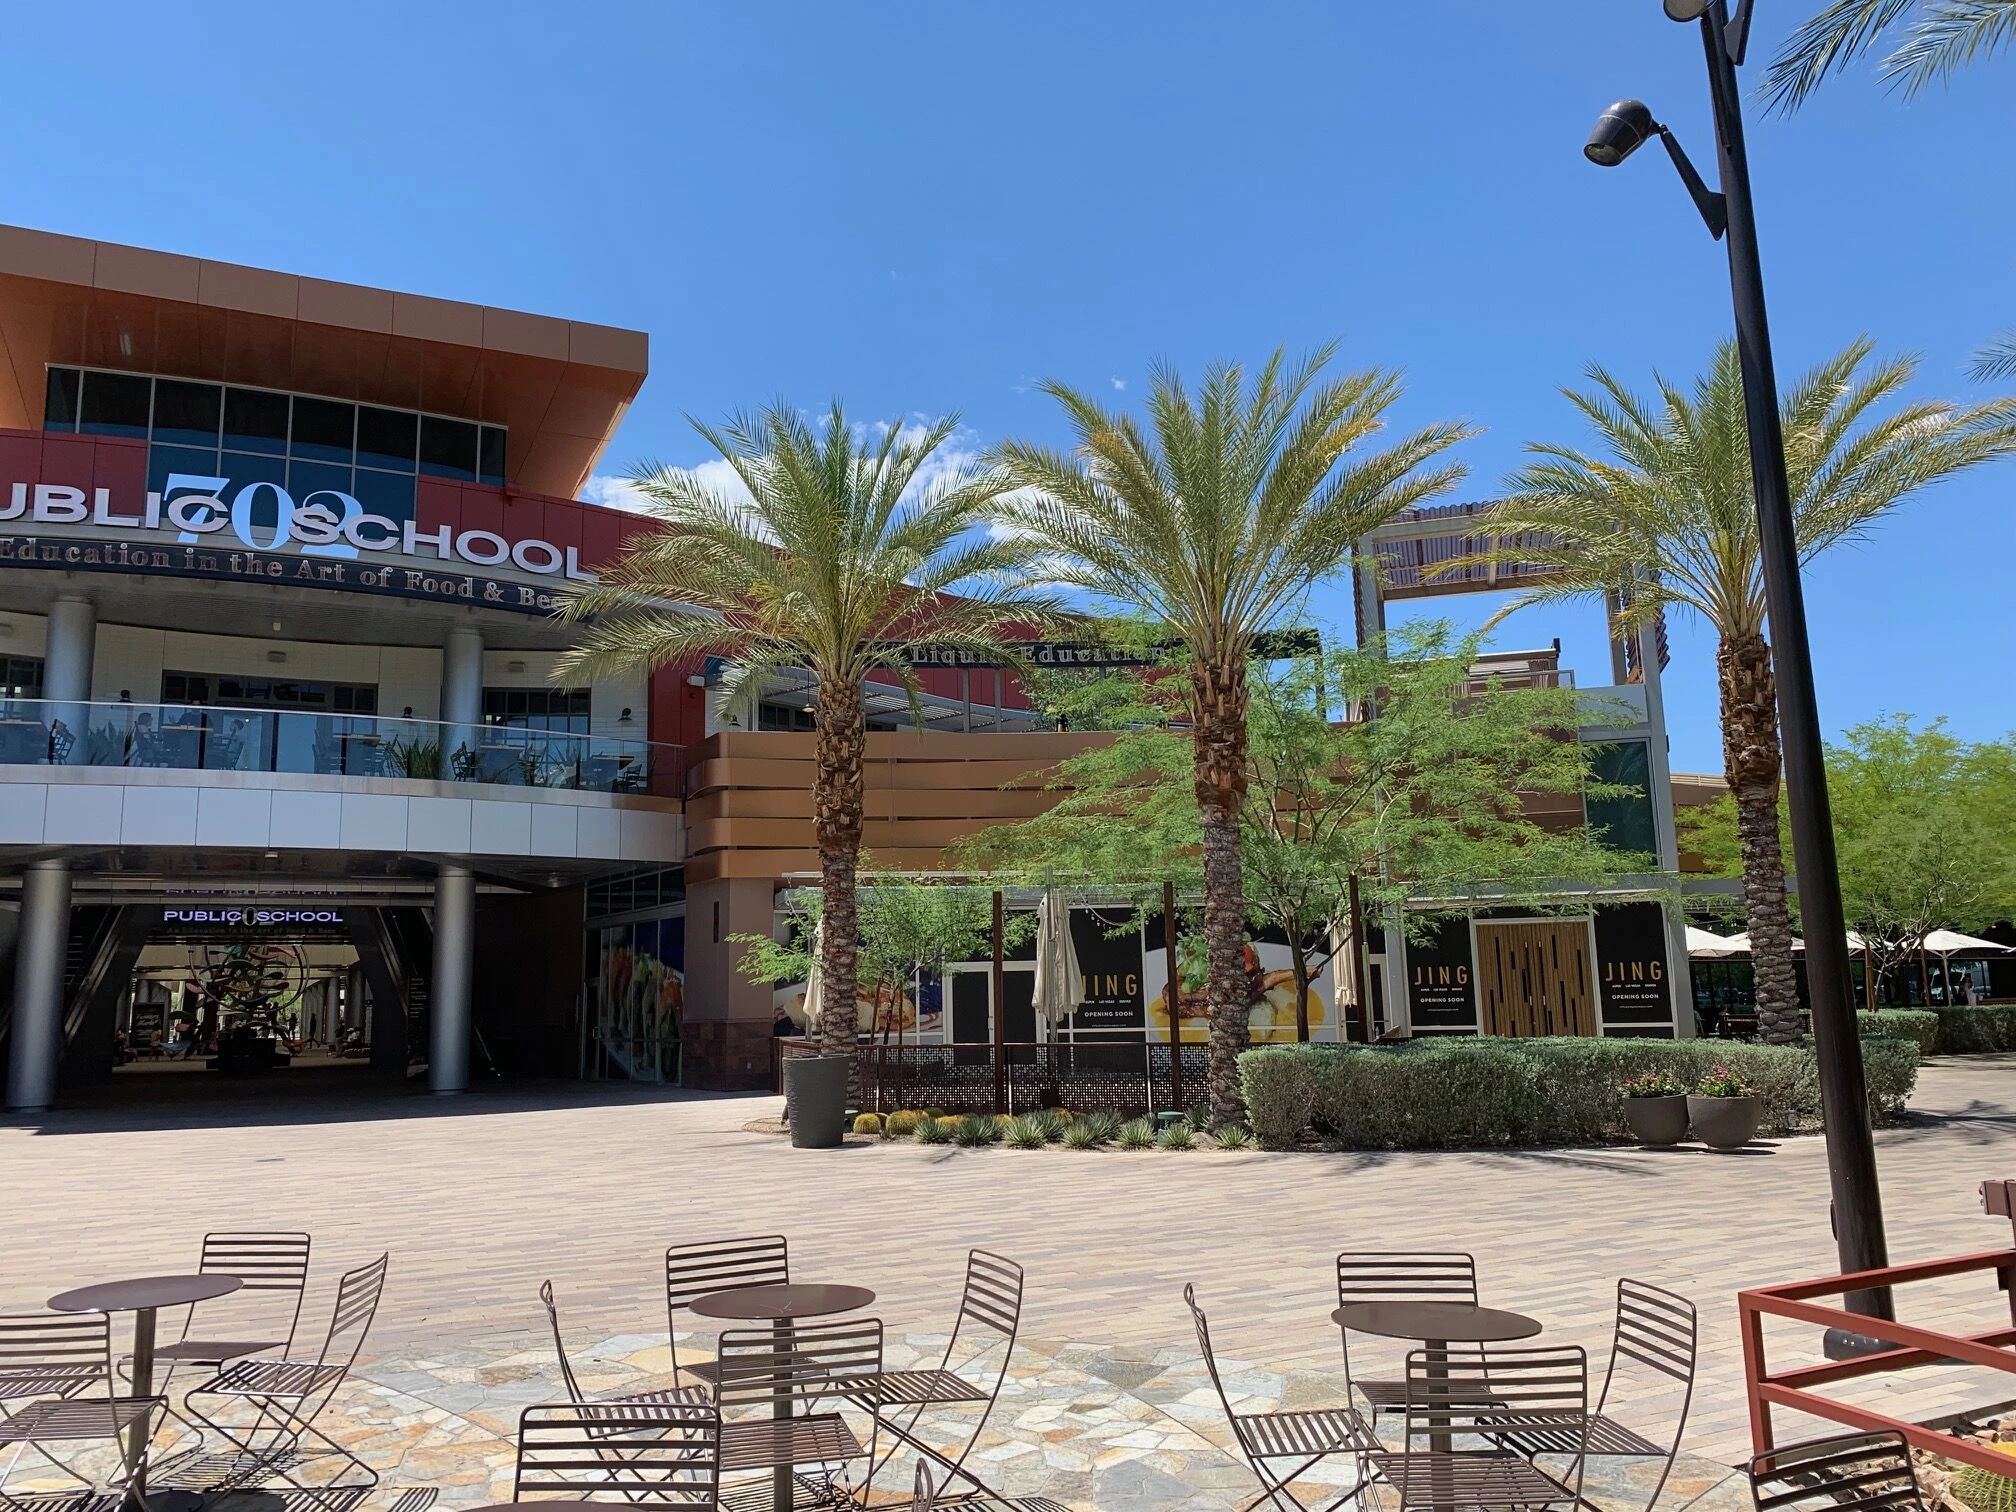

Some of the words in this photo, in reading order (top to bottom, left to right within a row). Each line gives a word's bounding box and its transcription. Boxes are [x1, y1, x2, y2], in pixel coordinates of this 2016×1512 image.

[289, 507, 599, 581] SCHOOL
[184, 547, 225, 571] in
[229, 552, 283, 577] the
[293, 559, 346, 583] Art
[359, 566, 394, 588] of
[404, 570, 474, 599] Food
[484, 582, 504, 602] &
[163, 911, 242, 922] PUBLIC
[256, 911, 344, 922] SCHOOL
[1414, 965, 1468, 985] JING
[1605, 960, 1662, 982] JING
